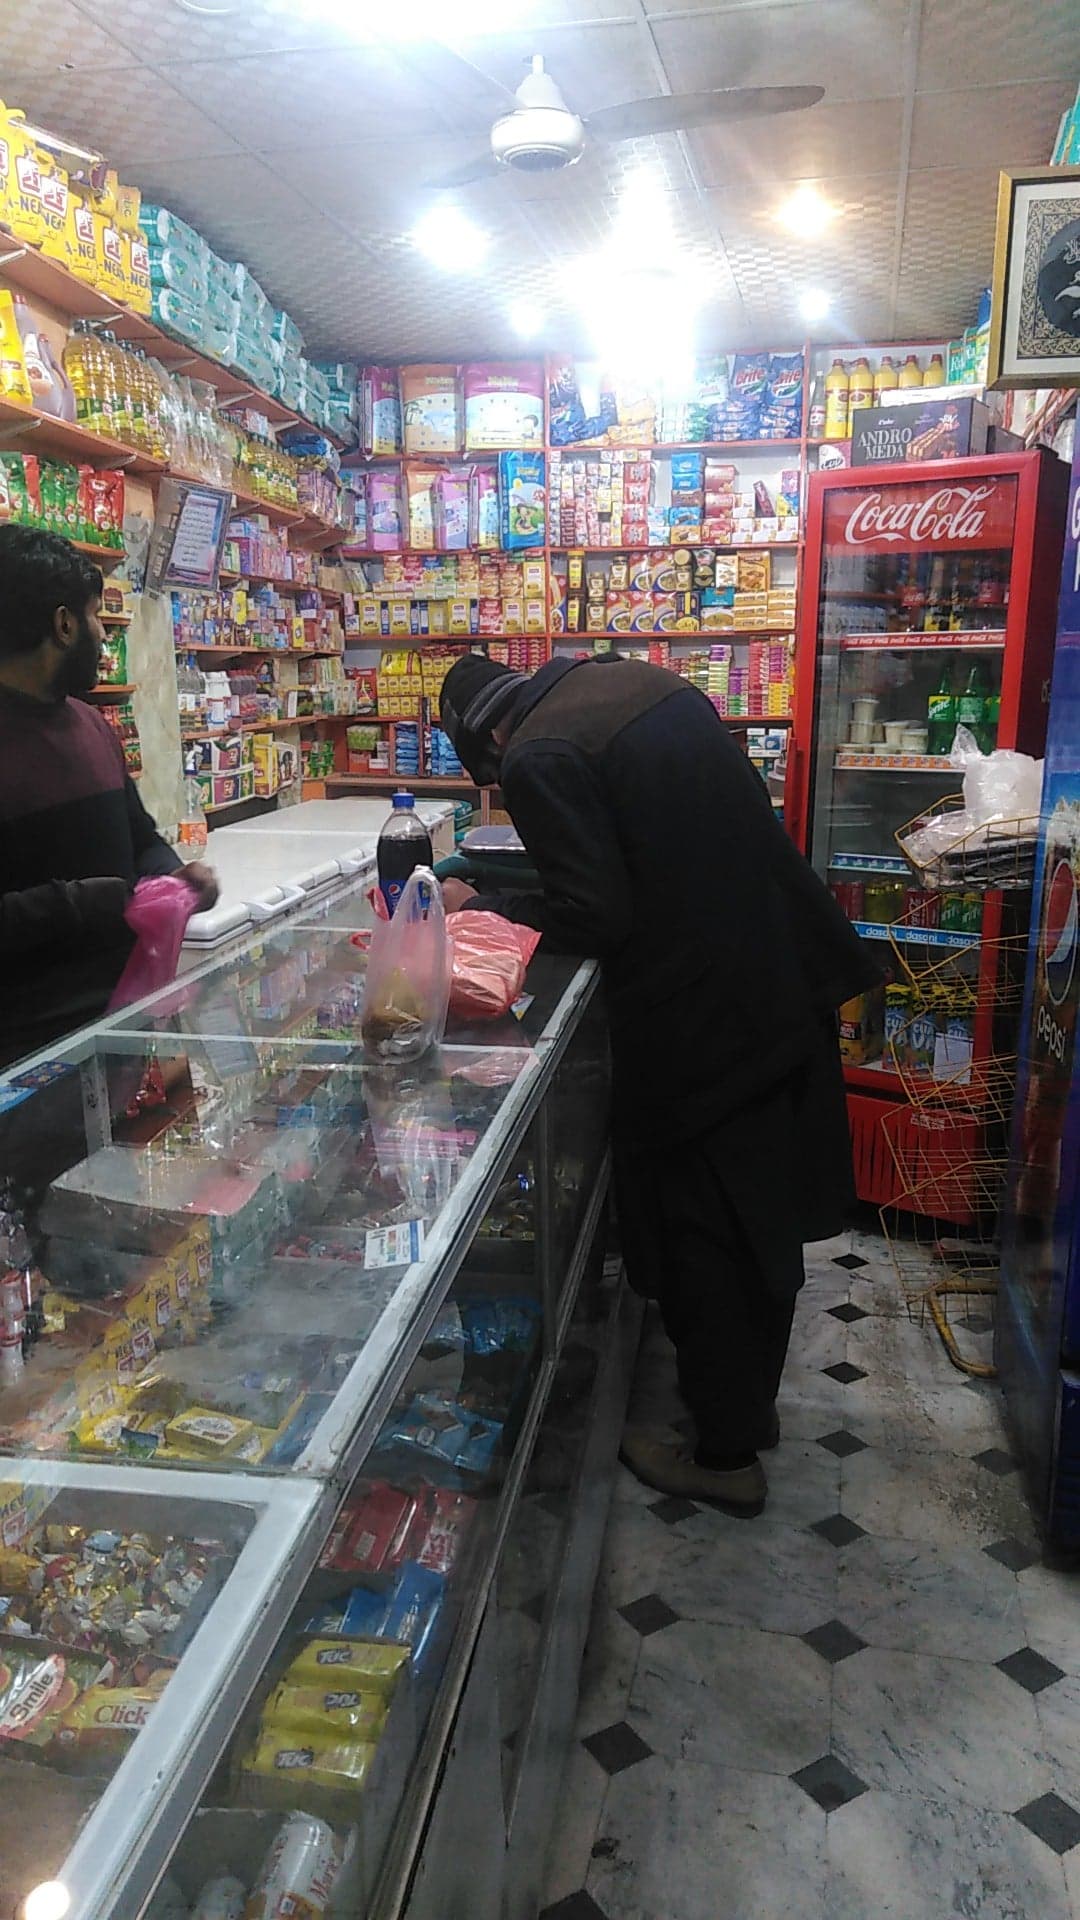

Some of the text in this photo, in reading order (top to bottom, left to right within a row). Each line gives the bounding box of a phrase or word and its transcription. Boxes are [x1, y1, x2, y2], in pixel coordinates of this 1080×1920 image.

[734, 368, 767, 387] Brite
[858, 428, 912, 448] ANDRO
[865, 444, 904, 460] MEDA
[845, 486, 997, 545] Coca-Cola
[905, 930, 938, 943] dasani
[1036, 1005, 1067, 1063] pepsi
[319, 1651, 350, 1665] TUC
[9, 1672, 54, 1722] Smile
[325, 1693, 359, 1708] TUC
[94, 1704, 150, 1726] Click
[277, 1752, 311, 1767] TUC
